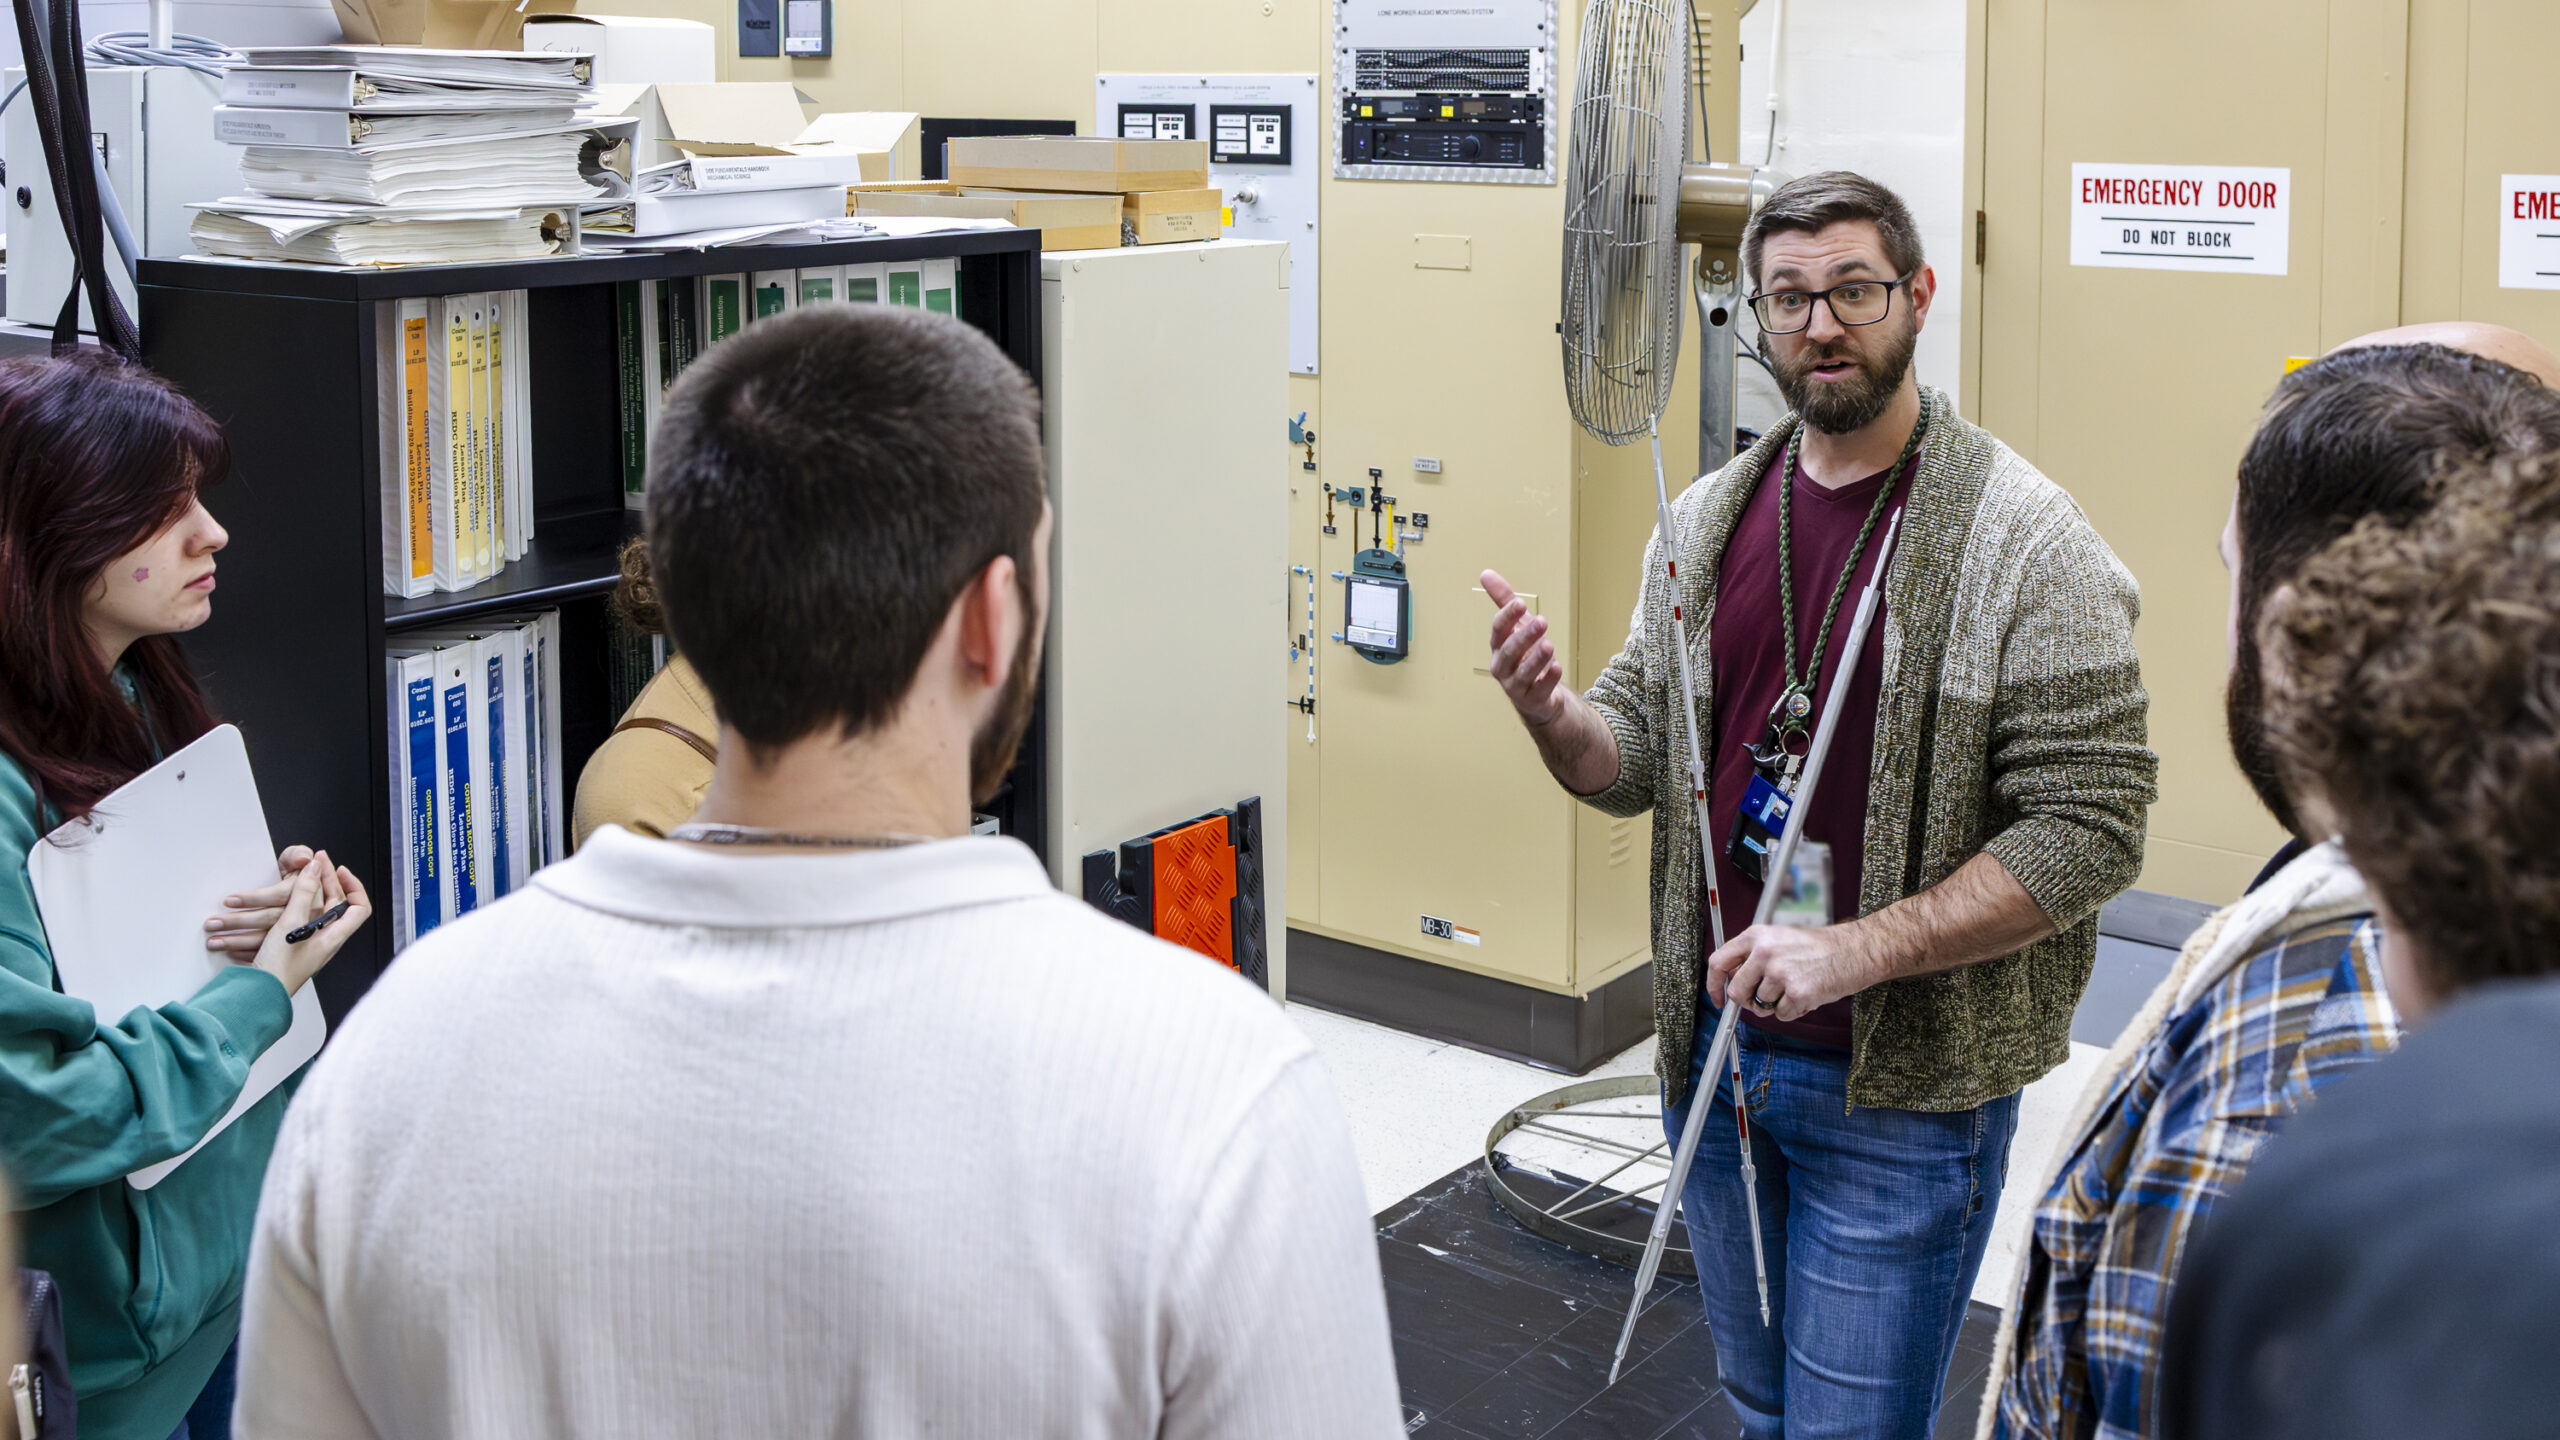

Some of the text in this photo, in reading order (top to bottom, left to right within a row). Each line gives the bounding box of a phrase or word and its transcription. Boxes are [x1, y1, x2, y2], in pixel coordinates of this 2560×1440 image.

[2082, 177, 2277, 210] EMERGENCY DOOR
[2513, 191, 2560, 219] EME
[2122, 228, 2232, 249] DO NOT BLOCK
[423, 410, 431, 464] CONTROL
[452, 443, 460, 497] Ventilation
[412, 685, 431, 694] Course
[448, 692, 464, 701] Course
[448, 796, 456, 821] Alpha
[464, 783, 472, 829] CONTROL
[450, 822, 458, 848] Glove
[453, 867, 461, 914] Operations
[1422, 917, 1451, 938] MB-30
